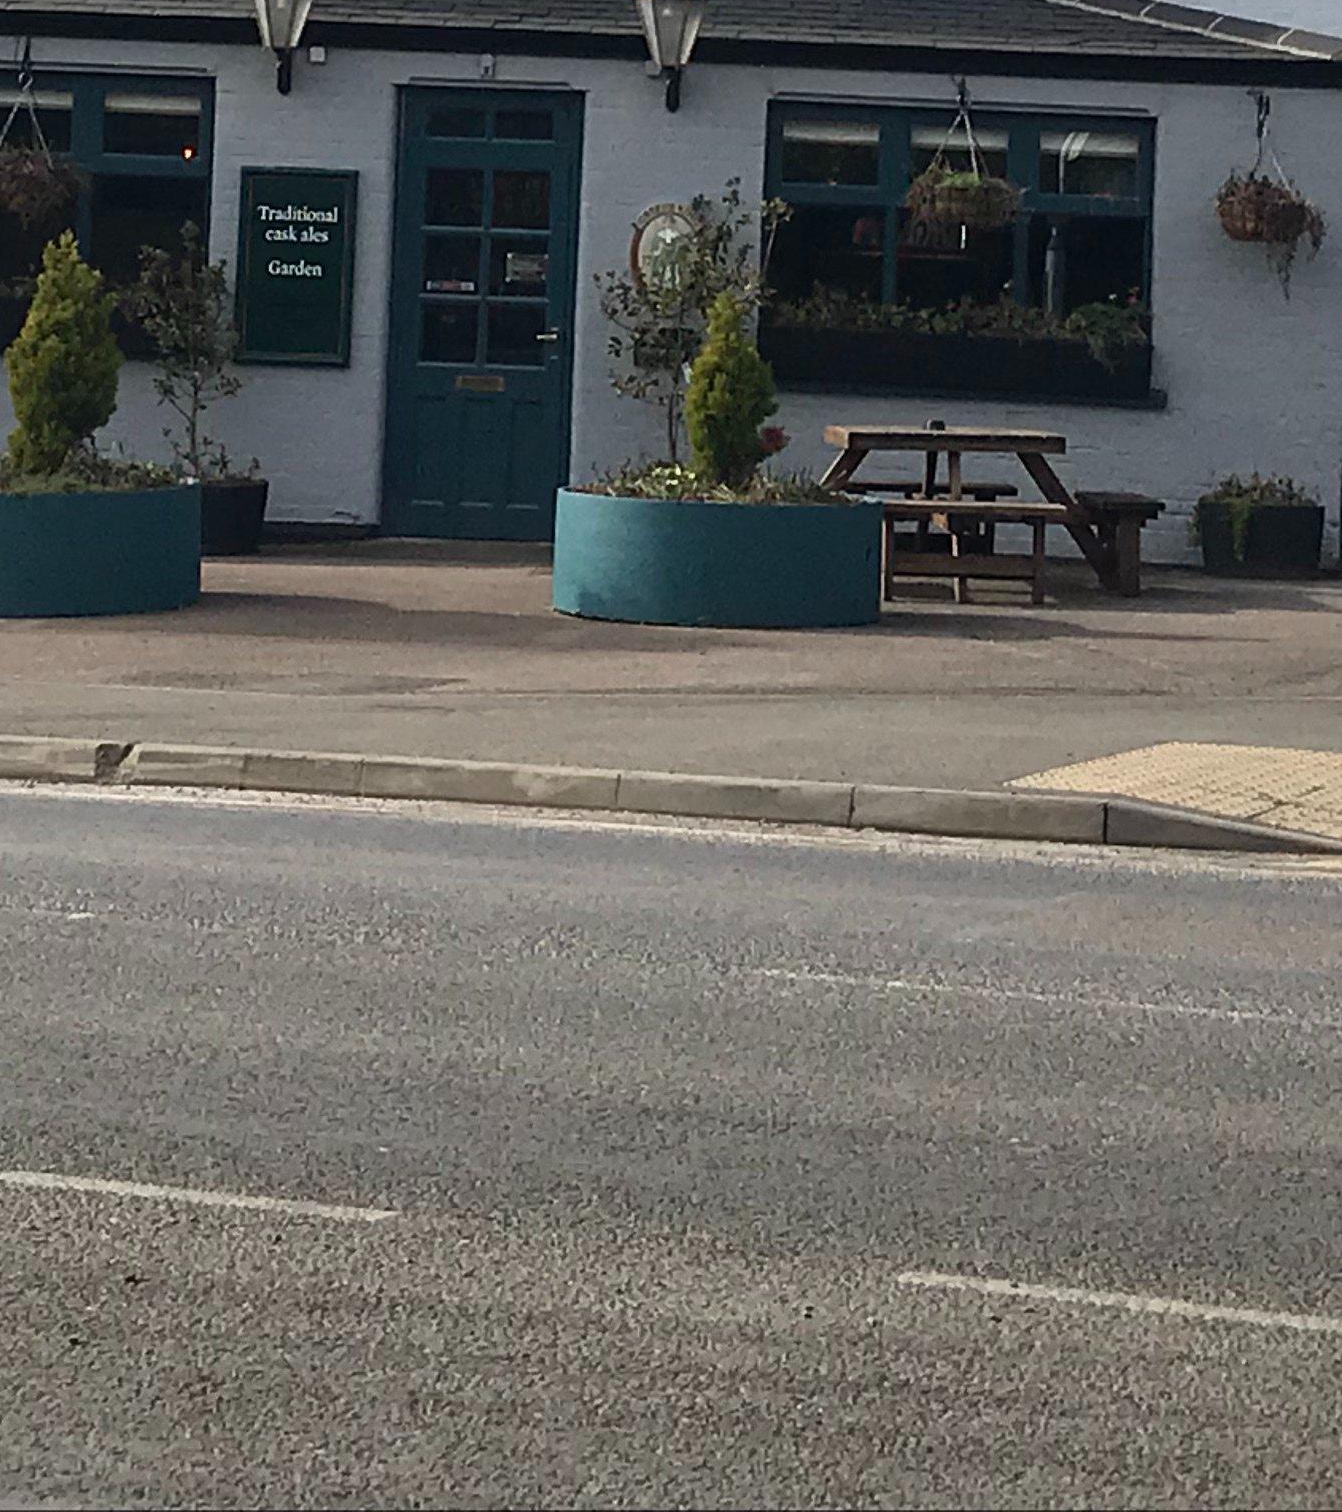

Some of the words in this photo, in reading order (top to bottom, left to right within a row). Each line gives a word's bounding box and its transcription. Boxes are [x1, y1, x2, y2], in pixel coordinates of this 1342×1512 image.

[257, 204, 339, 224] Traditional
[265, 225, 298, 242] cask
[300, 226, 329, 243] ales
[268, 259, 323, 278] Garden
